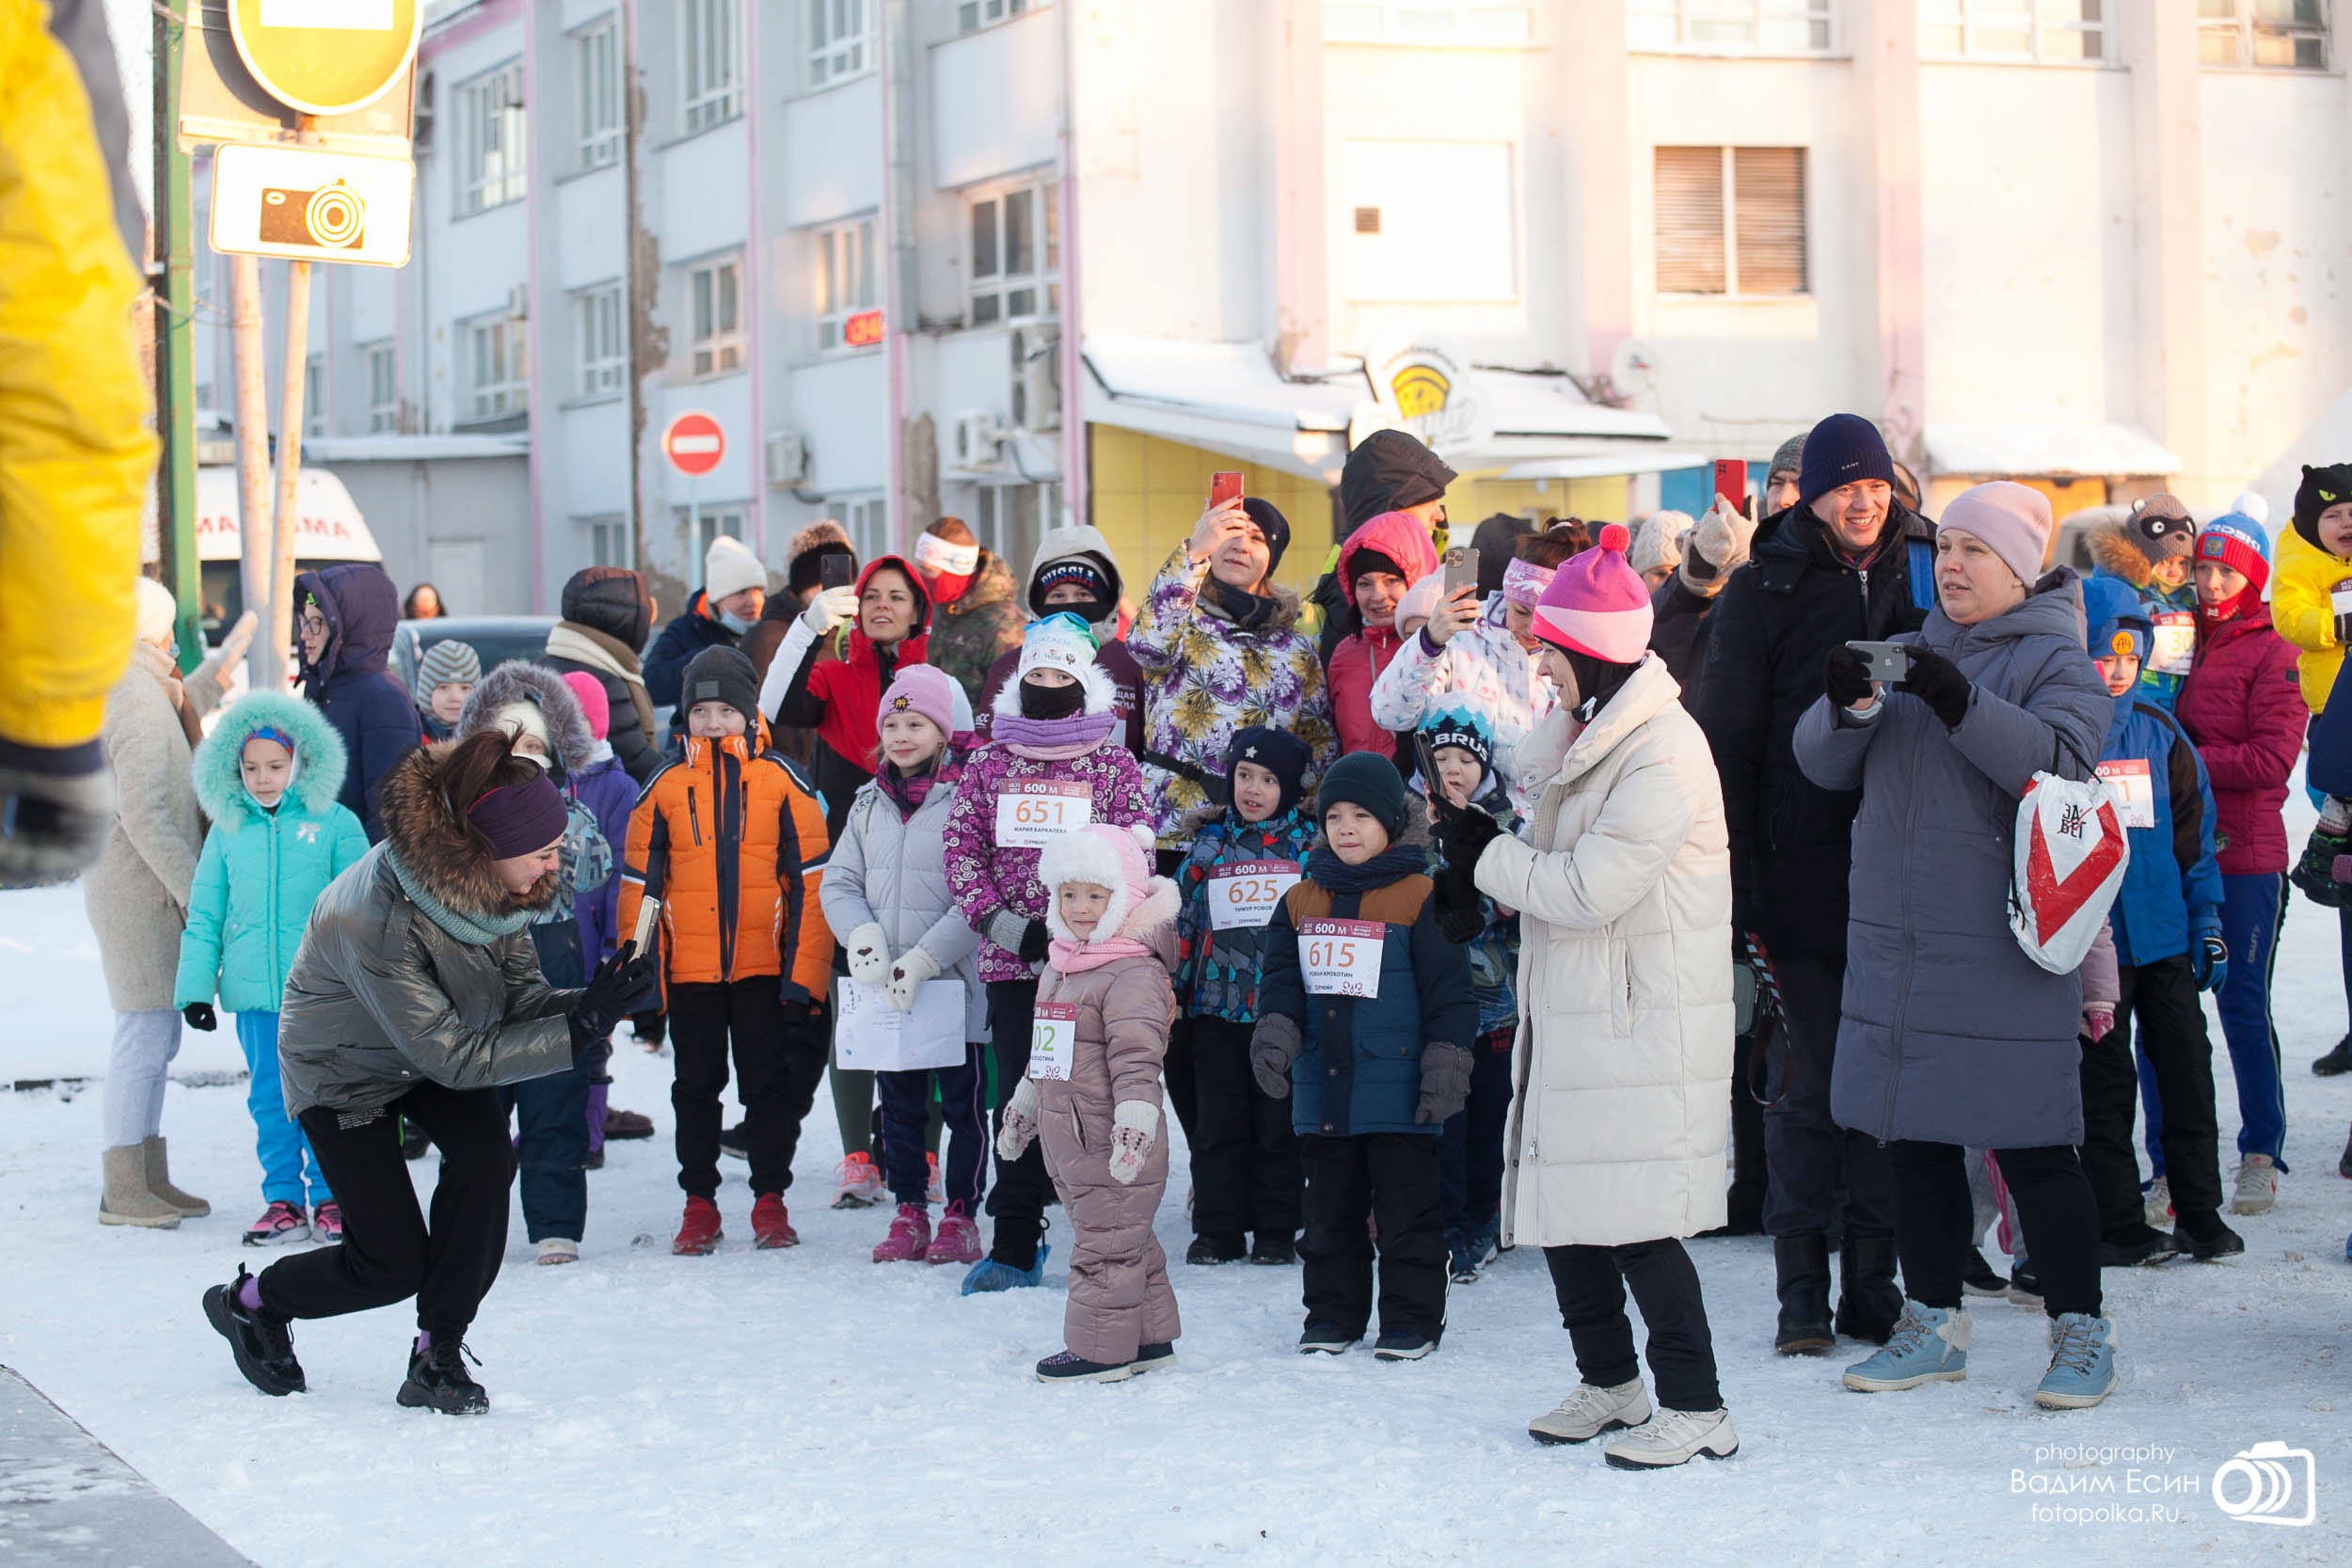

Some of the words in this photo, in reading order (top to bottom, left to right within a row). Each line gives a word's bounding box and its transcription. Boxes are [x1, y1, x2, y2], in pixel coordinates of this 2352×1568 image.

[1041, 565, 1095, 592] RUSSIA
[1431, 732, 1488, 763] BRUS
[1024, 783, 1047, 794] 600
[1016, 800, 1064, 824] 651
[1234, 864, 1256, 875] 600
[1229, 880, 1279, 904] 625
[1314, 923, 1336, 934] 600
[1309, 941, 1356, 968] 615
[1034, 1024, 1056, 1052] 02
